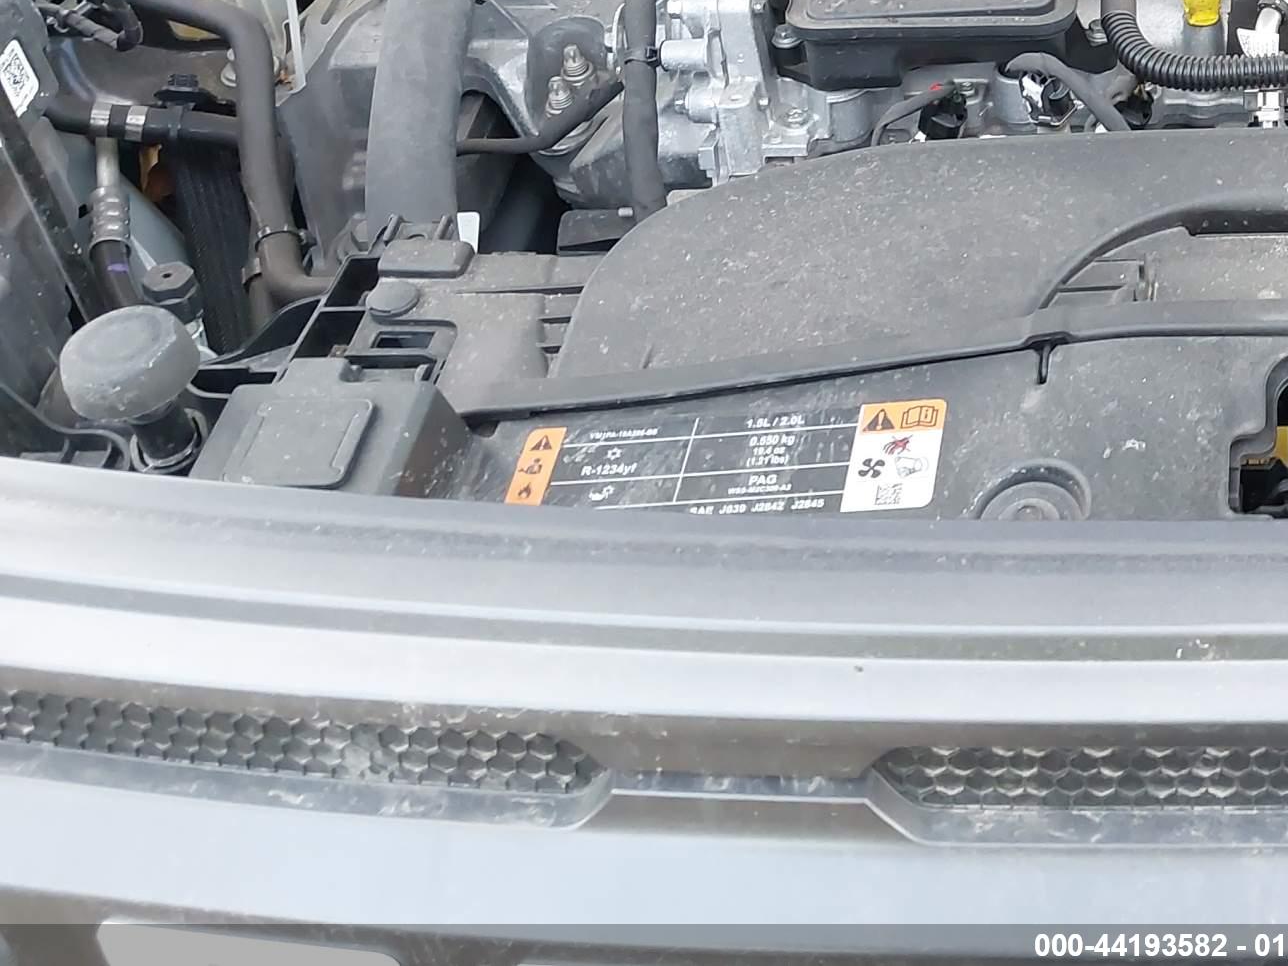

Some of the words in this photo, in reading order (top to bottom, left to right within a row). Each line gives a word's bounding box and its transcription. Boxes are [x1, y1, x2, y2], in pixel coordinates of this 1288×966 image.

[779, 414, 805, 426] 2.0L
[780, 434, 796, 446] kg
[580, 462, 638, 476] R-1234yf
[748, 474, 778, 486] PAG
